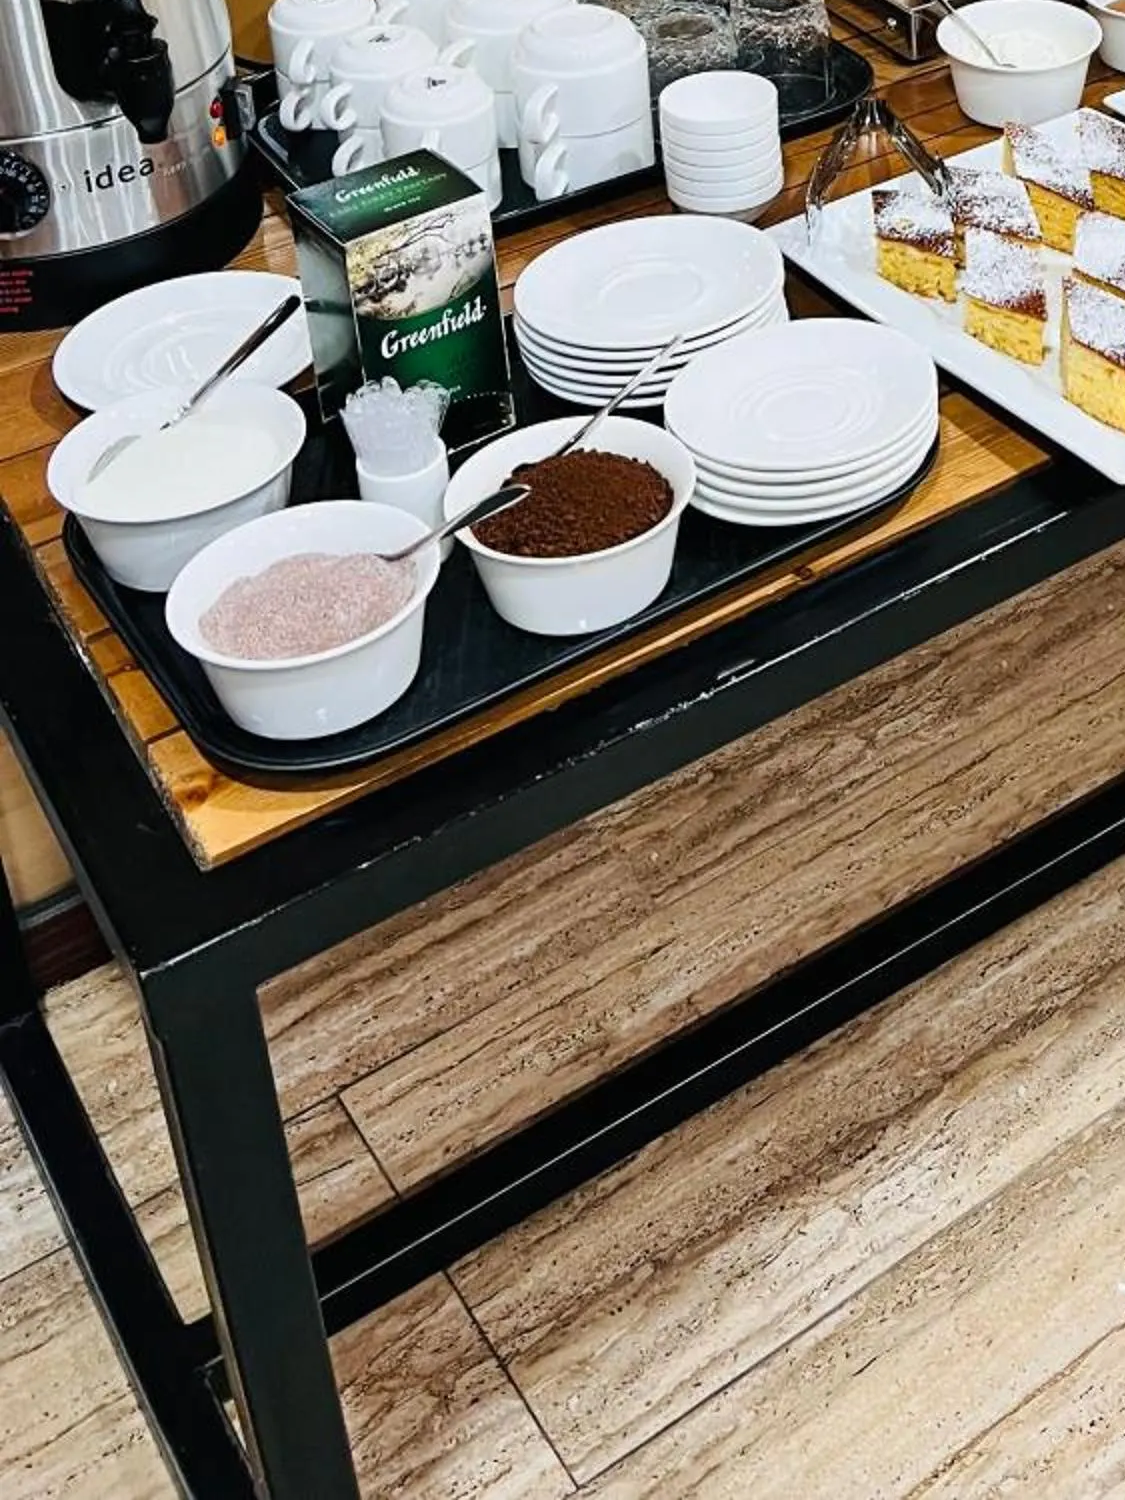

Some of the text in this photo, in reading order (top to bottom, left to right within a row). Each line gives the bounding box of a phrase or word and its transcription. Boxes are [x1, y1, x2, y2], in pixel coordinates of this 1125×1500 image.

[84, 157, 155, 193] idea
[335, 165, 421, 204] Greenfield
[380, 296, 485, 360] Greenfield
